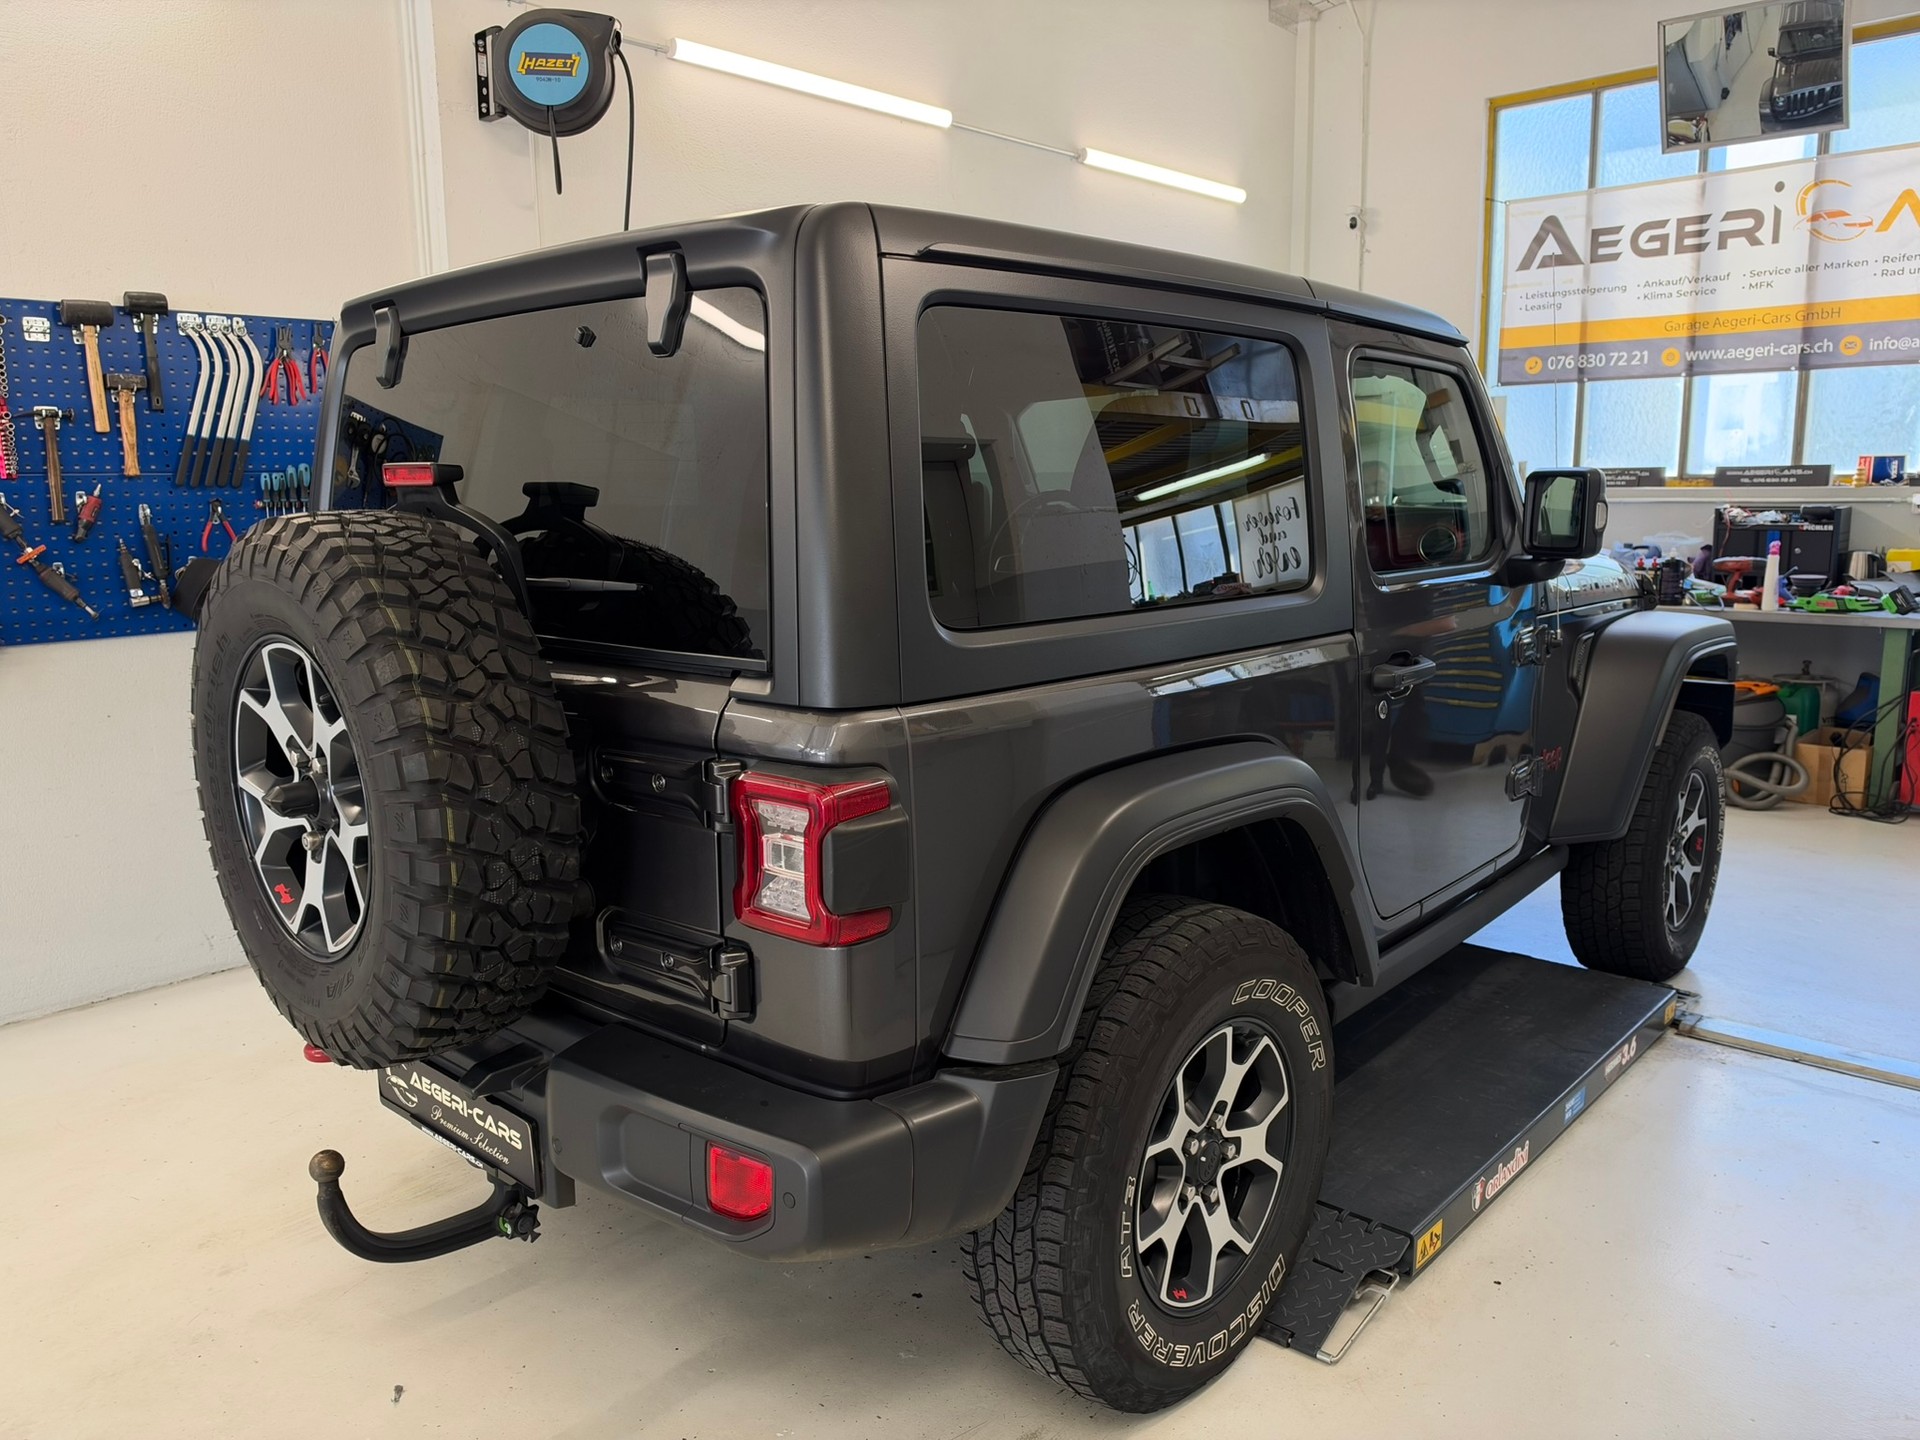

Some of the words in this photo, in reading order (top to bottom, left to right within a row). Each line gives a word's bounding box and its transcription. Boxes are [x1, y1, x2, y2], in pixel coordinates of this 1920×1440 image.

[522, 55, 576, 72] HAZET
[1749, 266, 1791, 278] Service
[1794, 264, 1821, 274] aller
[1823, 259, 1869, 270] Marken
[1881, 266, 1905, 277] Rad
[1643, 272, 1731, 289] Ankauf/Verkauf
[1748, 280, 1774, 291] MFK
[1525, 283, 1627, 301] Leistungssteigerung
[1643, 290, 1673, 301] Klima
[1675, 286, 1717, 298] Service
[1525, 301, 1563, 313] Leasing
[1664, 317, 1709, 333] Garage
[1713, 310, 1791, 331] Aegeri-Cars
[1795, 307, 1841, 322] GmbH
[1685, 338, 1833, 361] www.aegeri-cars.ch
[1869, 336, 1920, 351] info@a
[1547, 356, 1574, 370] 076
[1577, 353, 1606, 369] 830
[1609, 351, 1629, 367] 72
[1631, 350, 1648, 366] 21
[1231, 979, 1328, 1072] COOPER
[409, 1071, 523, 1151] AEGERI-CARS
[430, 1104, 470, 1141] Premium
[469, 1132, 510, 1166] Selection
[1127, 1253, 1286, 1368] DISCOVERER
